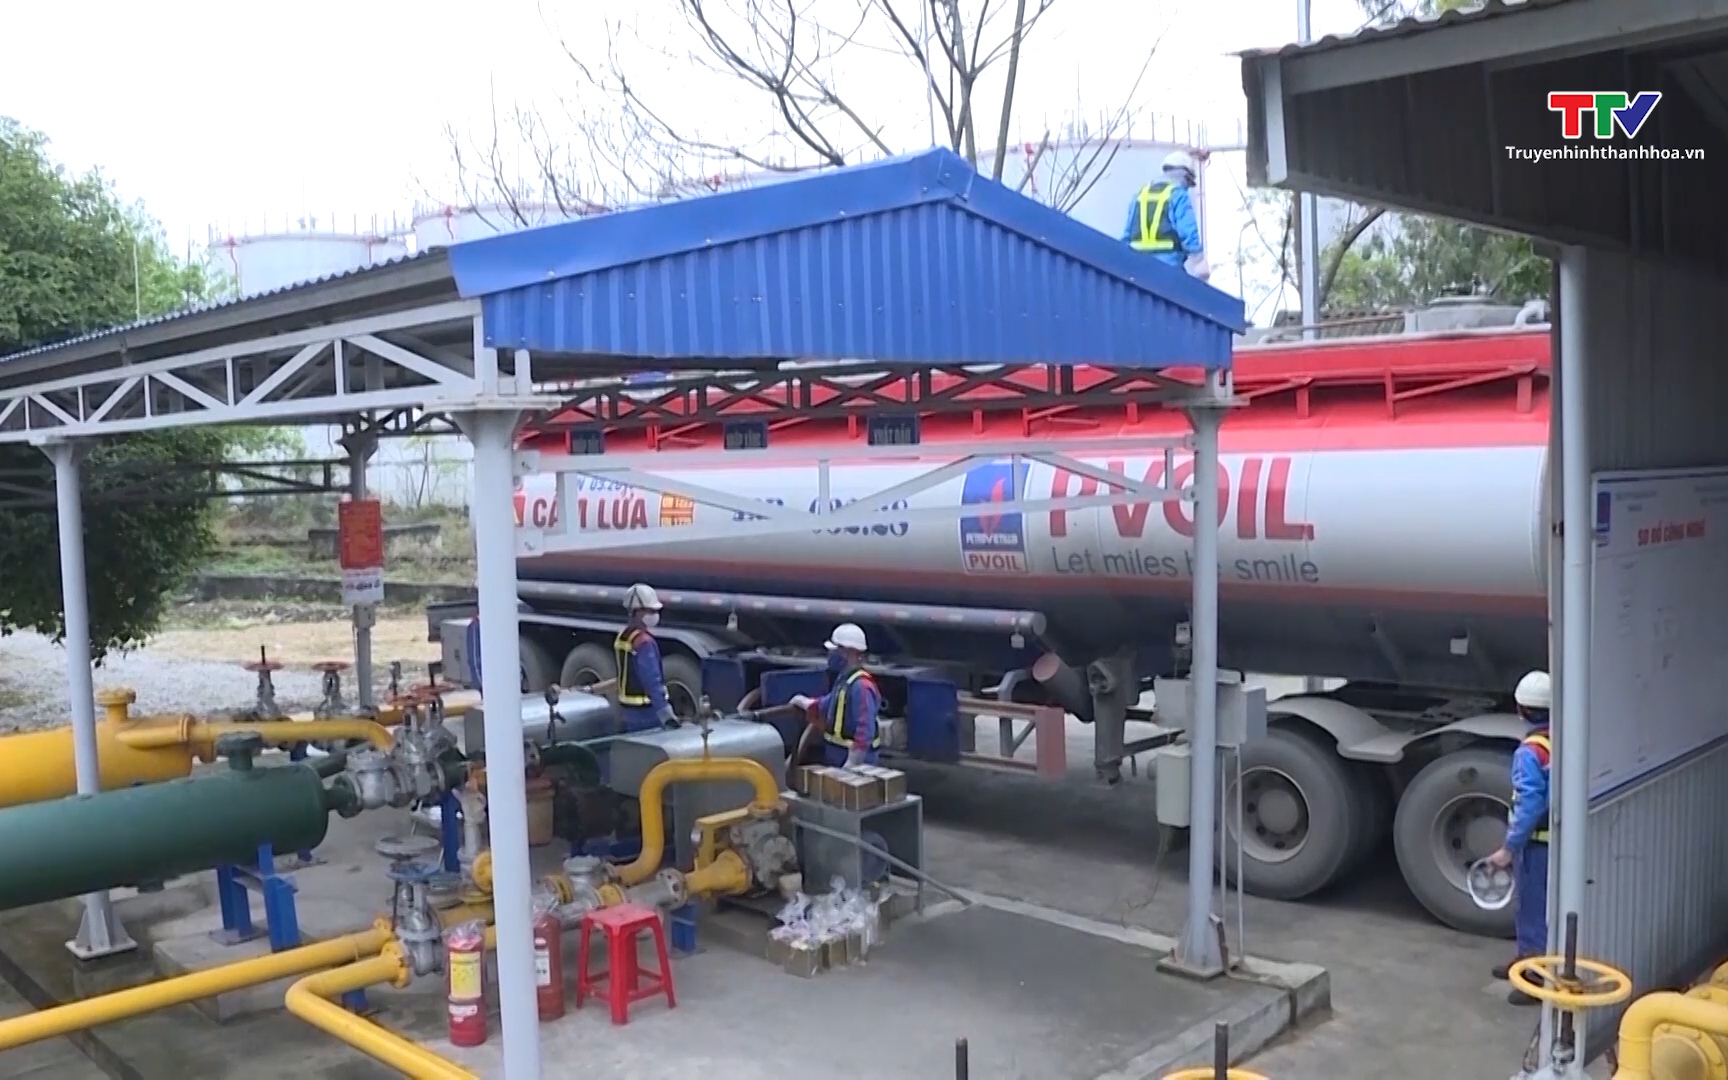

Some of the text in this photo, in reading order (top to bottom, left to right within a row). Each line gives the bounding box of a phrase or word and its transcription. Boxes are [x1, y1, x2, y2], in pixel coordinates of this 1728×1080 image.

[1049, 456, 1314, 541] PVOIL
[969, 553, 1022, 571] PVOIL
[1052, 546, 1094, 574] Let
[1103, 550, 1178, 577] miles
[1234, 553, 1320, 584] smile
